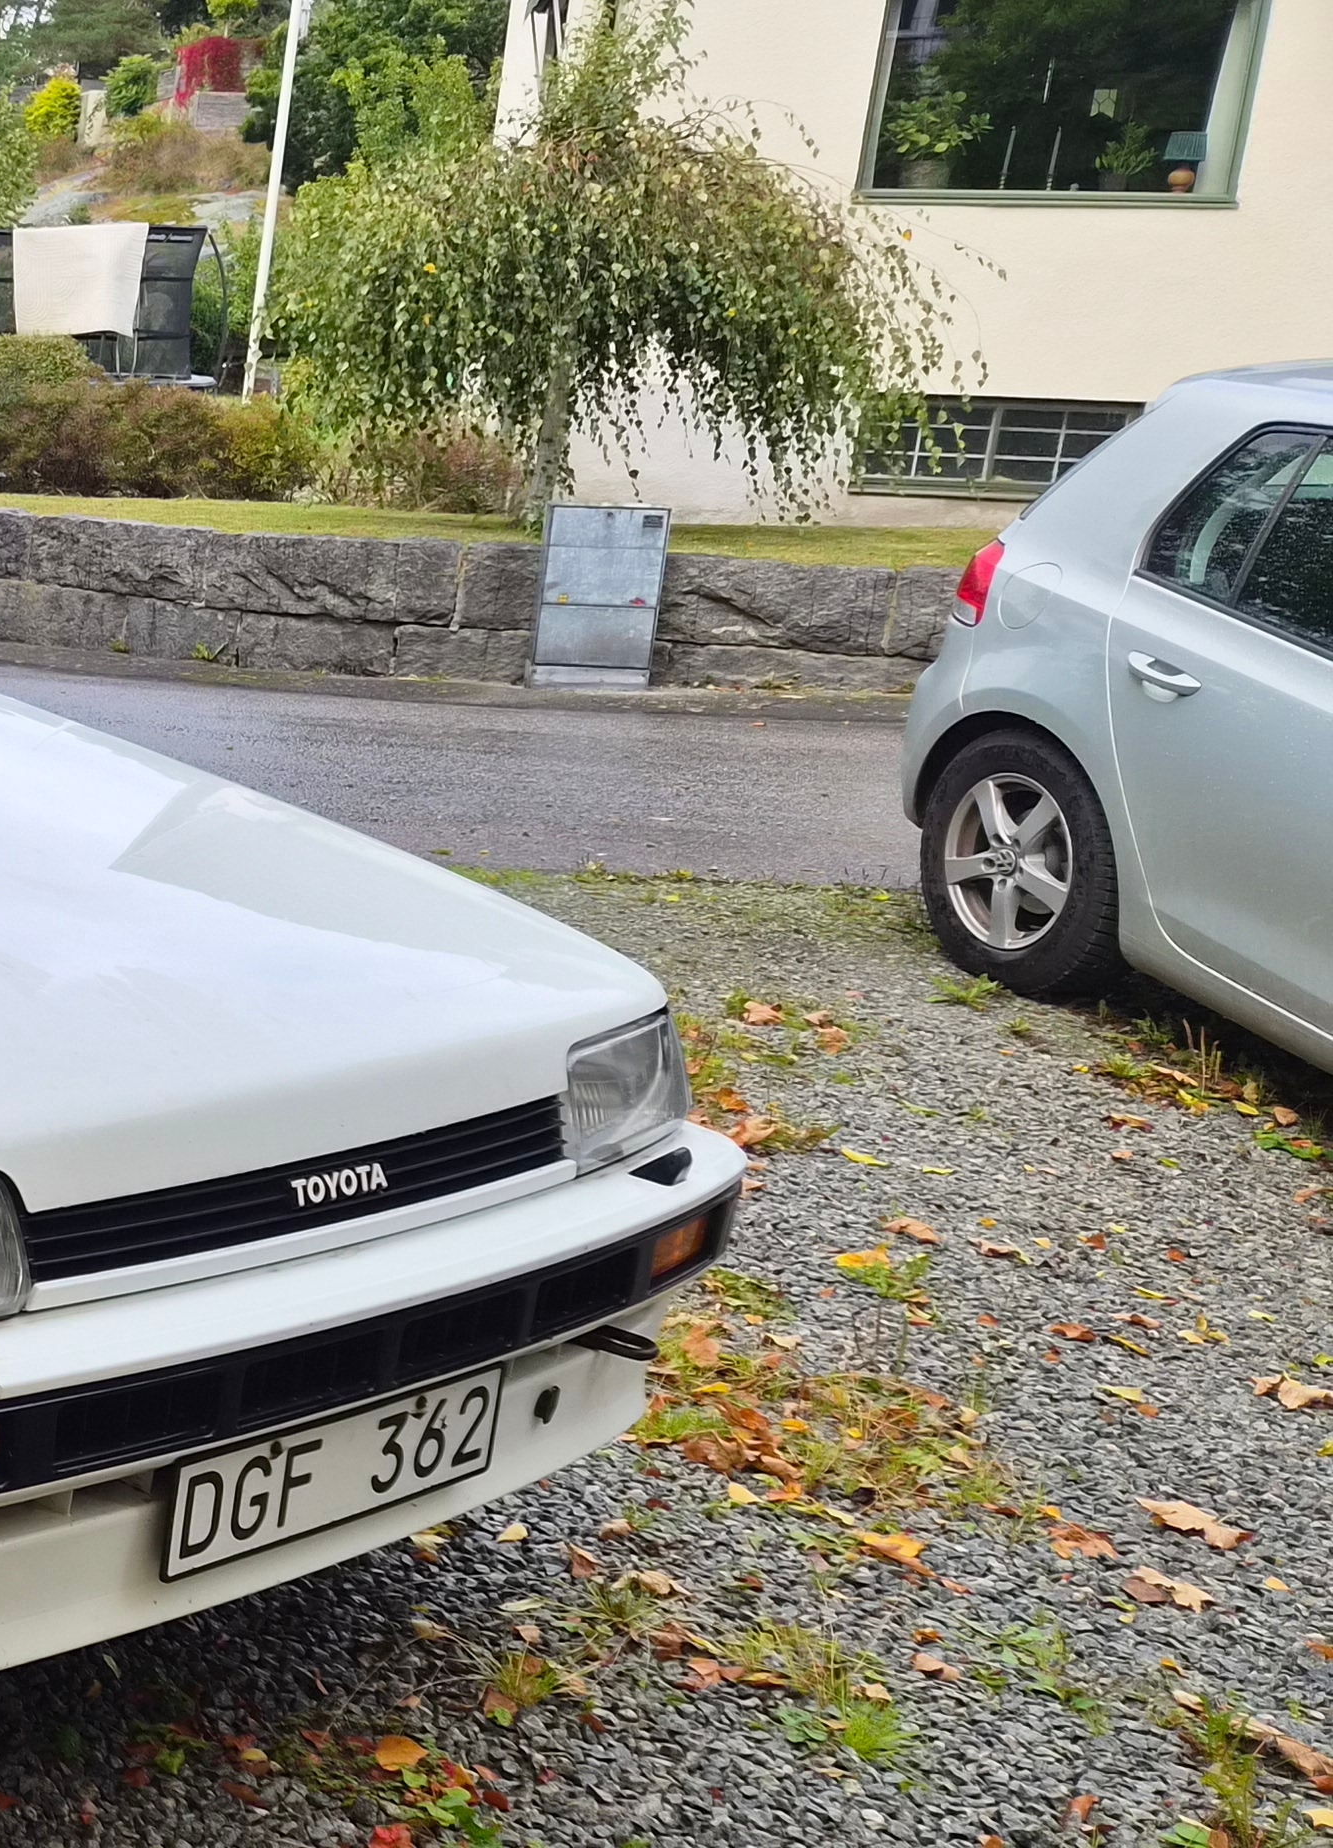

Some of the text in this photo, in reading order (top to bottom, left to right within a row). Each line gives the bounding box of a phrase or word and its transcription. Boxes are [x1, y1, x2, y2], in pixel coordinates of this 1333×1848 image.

[290, 1162, 389, 1207] TOYOTA
[179, 1385, 491, 1560] DGF 362
